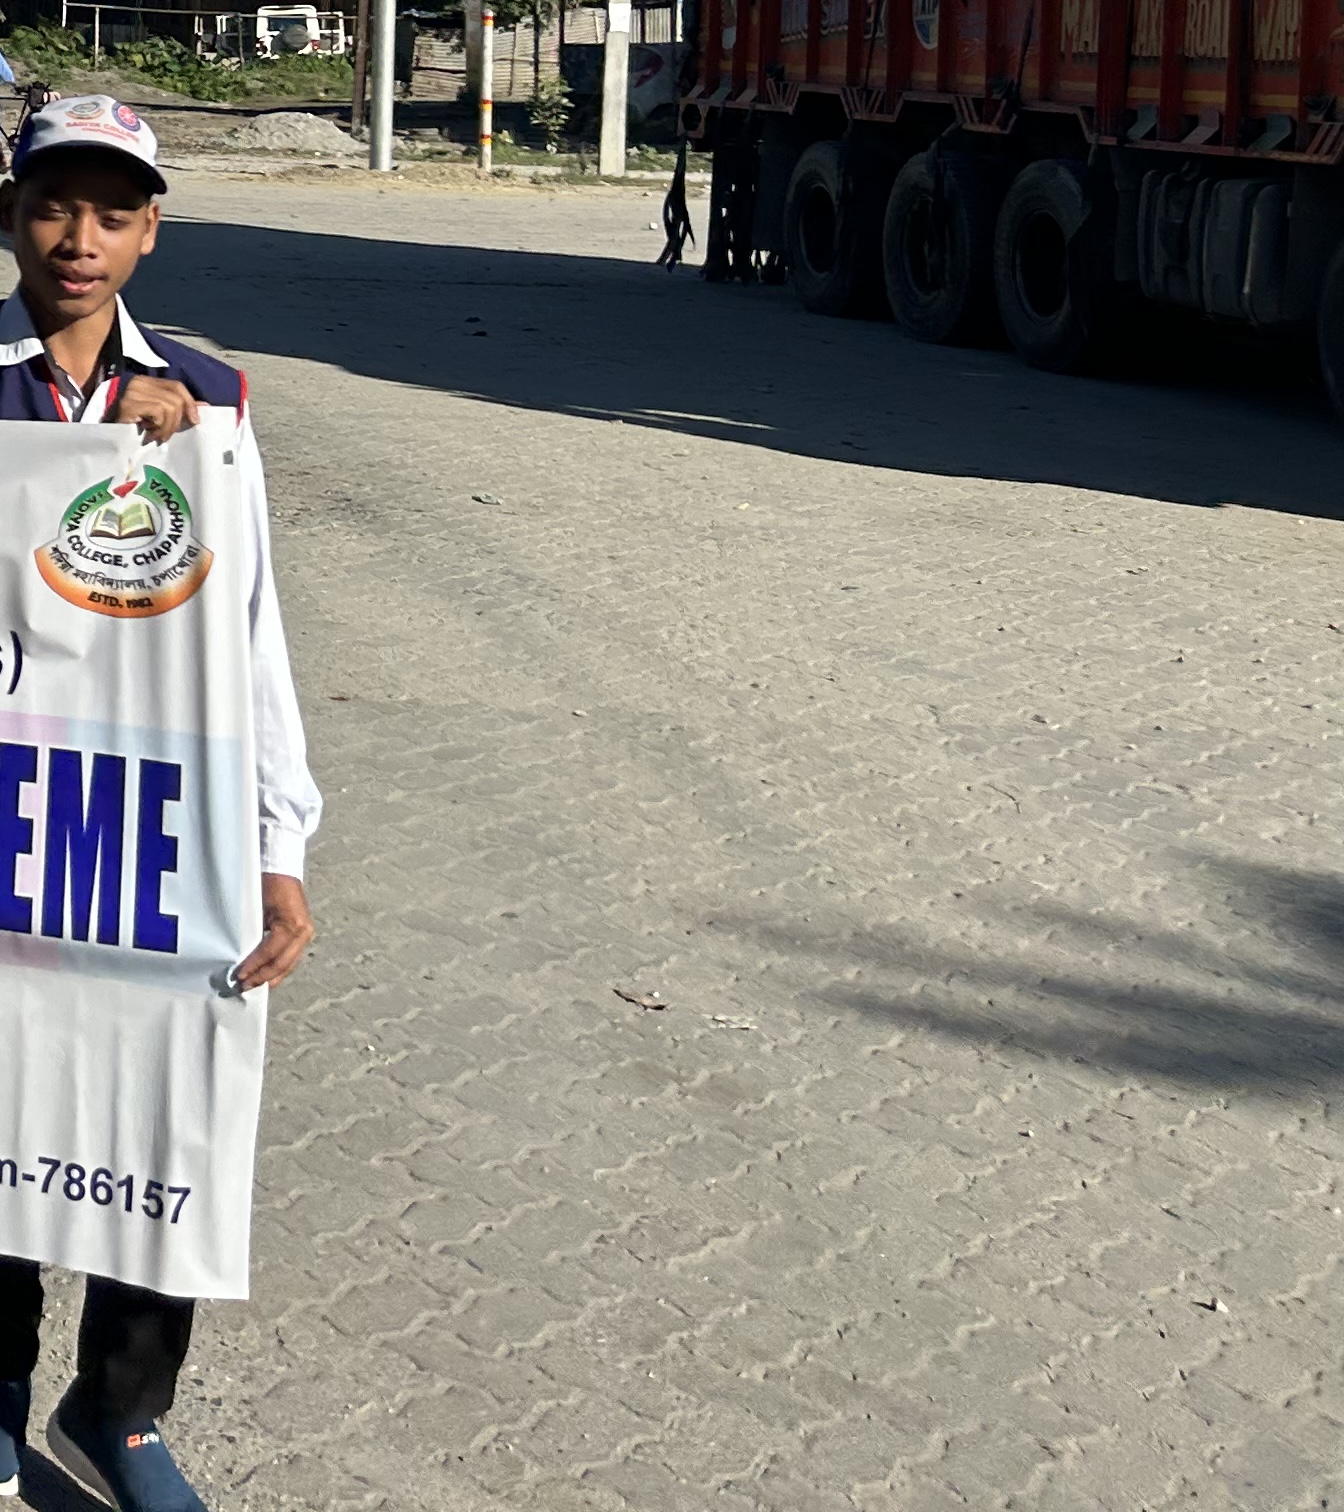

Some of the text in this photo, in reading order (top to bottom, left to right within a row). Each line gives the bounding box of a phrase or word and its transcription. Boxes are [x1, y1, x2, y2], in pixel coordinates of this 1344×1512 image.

[65, 478, 185, 568] SADIYA COLLEGE, CHAPAKHOWA
[87, 591, 124, 609] ESTD.
